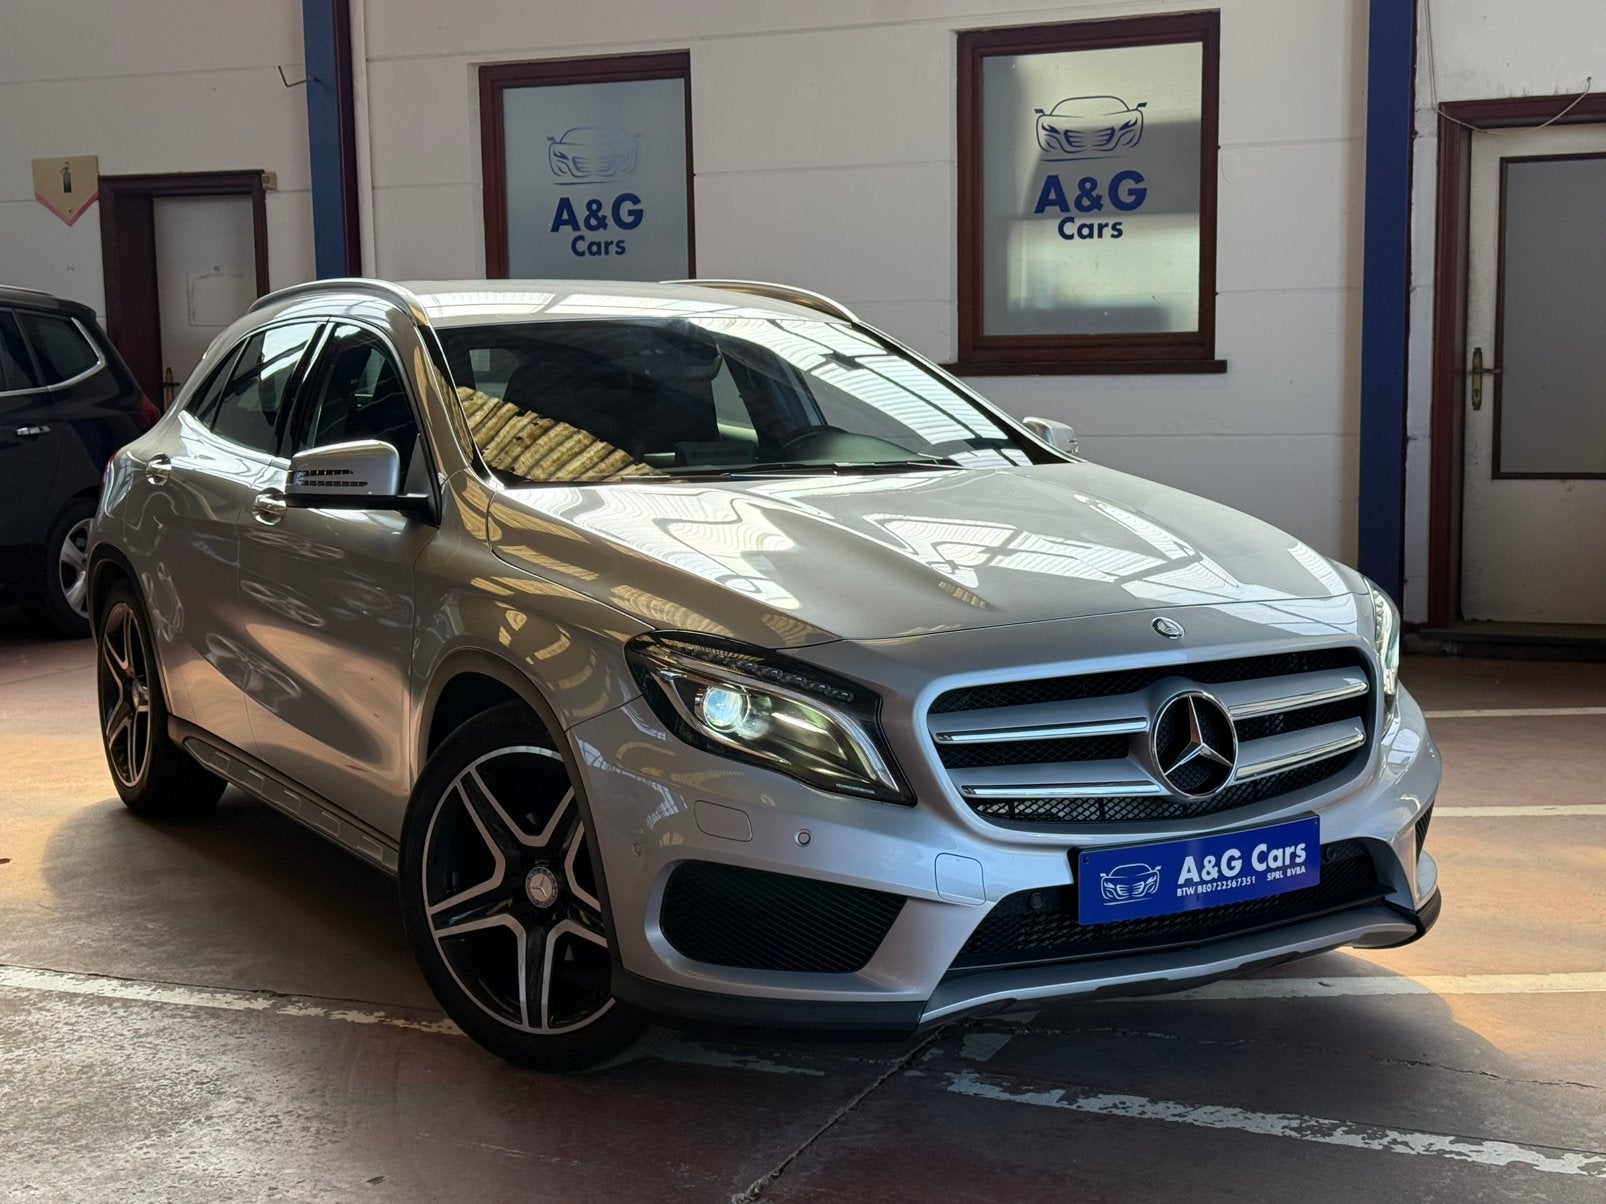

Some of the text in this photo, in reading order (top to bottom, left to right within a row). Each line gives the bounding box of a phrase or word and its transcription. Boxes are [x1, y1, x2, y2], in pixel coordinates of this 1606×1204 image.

[1034, 170, 1147, 214] A&G
[550, 193, 643, 232] A&G
[1058, 216, 1123, 240] Cars
[571, 235, 626, 256] Cars
[1176, 865, 1306, 897] BTW BE0722567351 SPRL BVBA
[1177, 843, 1306, 885] A&G Cars
